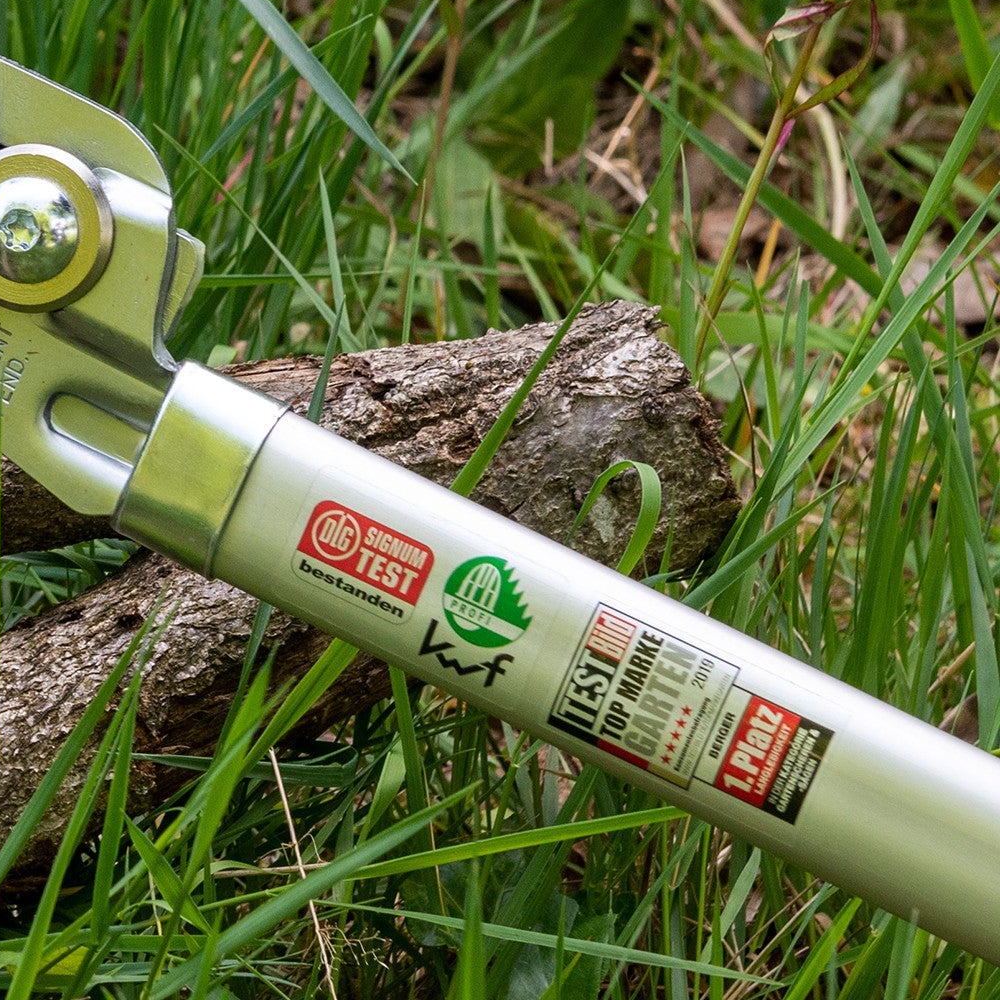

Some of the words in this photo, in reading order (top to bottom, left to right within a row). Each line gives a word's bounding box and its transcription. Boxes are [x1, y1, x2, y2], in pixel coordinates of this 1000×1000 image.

[355, 546, 419, 596] TEST
[364, 526, 428, 570] SIGNUM
[299, 559, 404, 618] bestanden
[450, 600, 491, 626] PROFI
[600, 700, 631, 741] TOP
[616, 630, 664, 703] MARKE
[691, 657, 715, 690] 2019
[623, 641, 698, 757] GARTEN
[709, 712, 736, 759] BERGER
